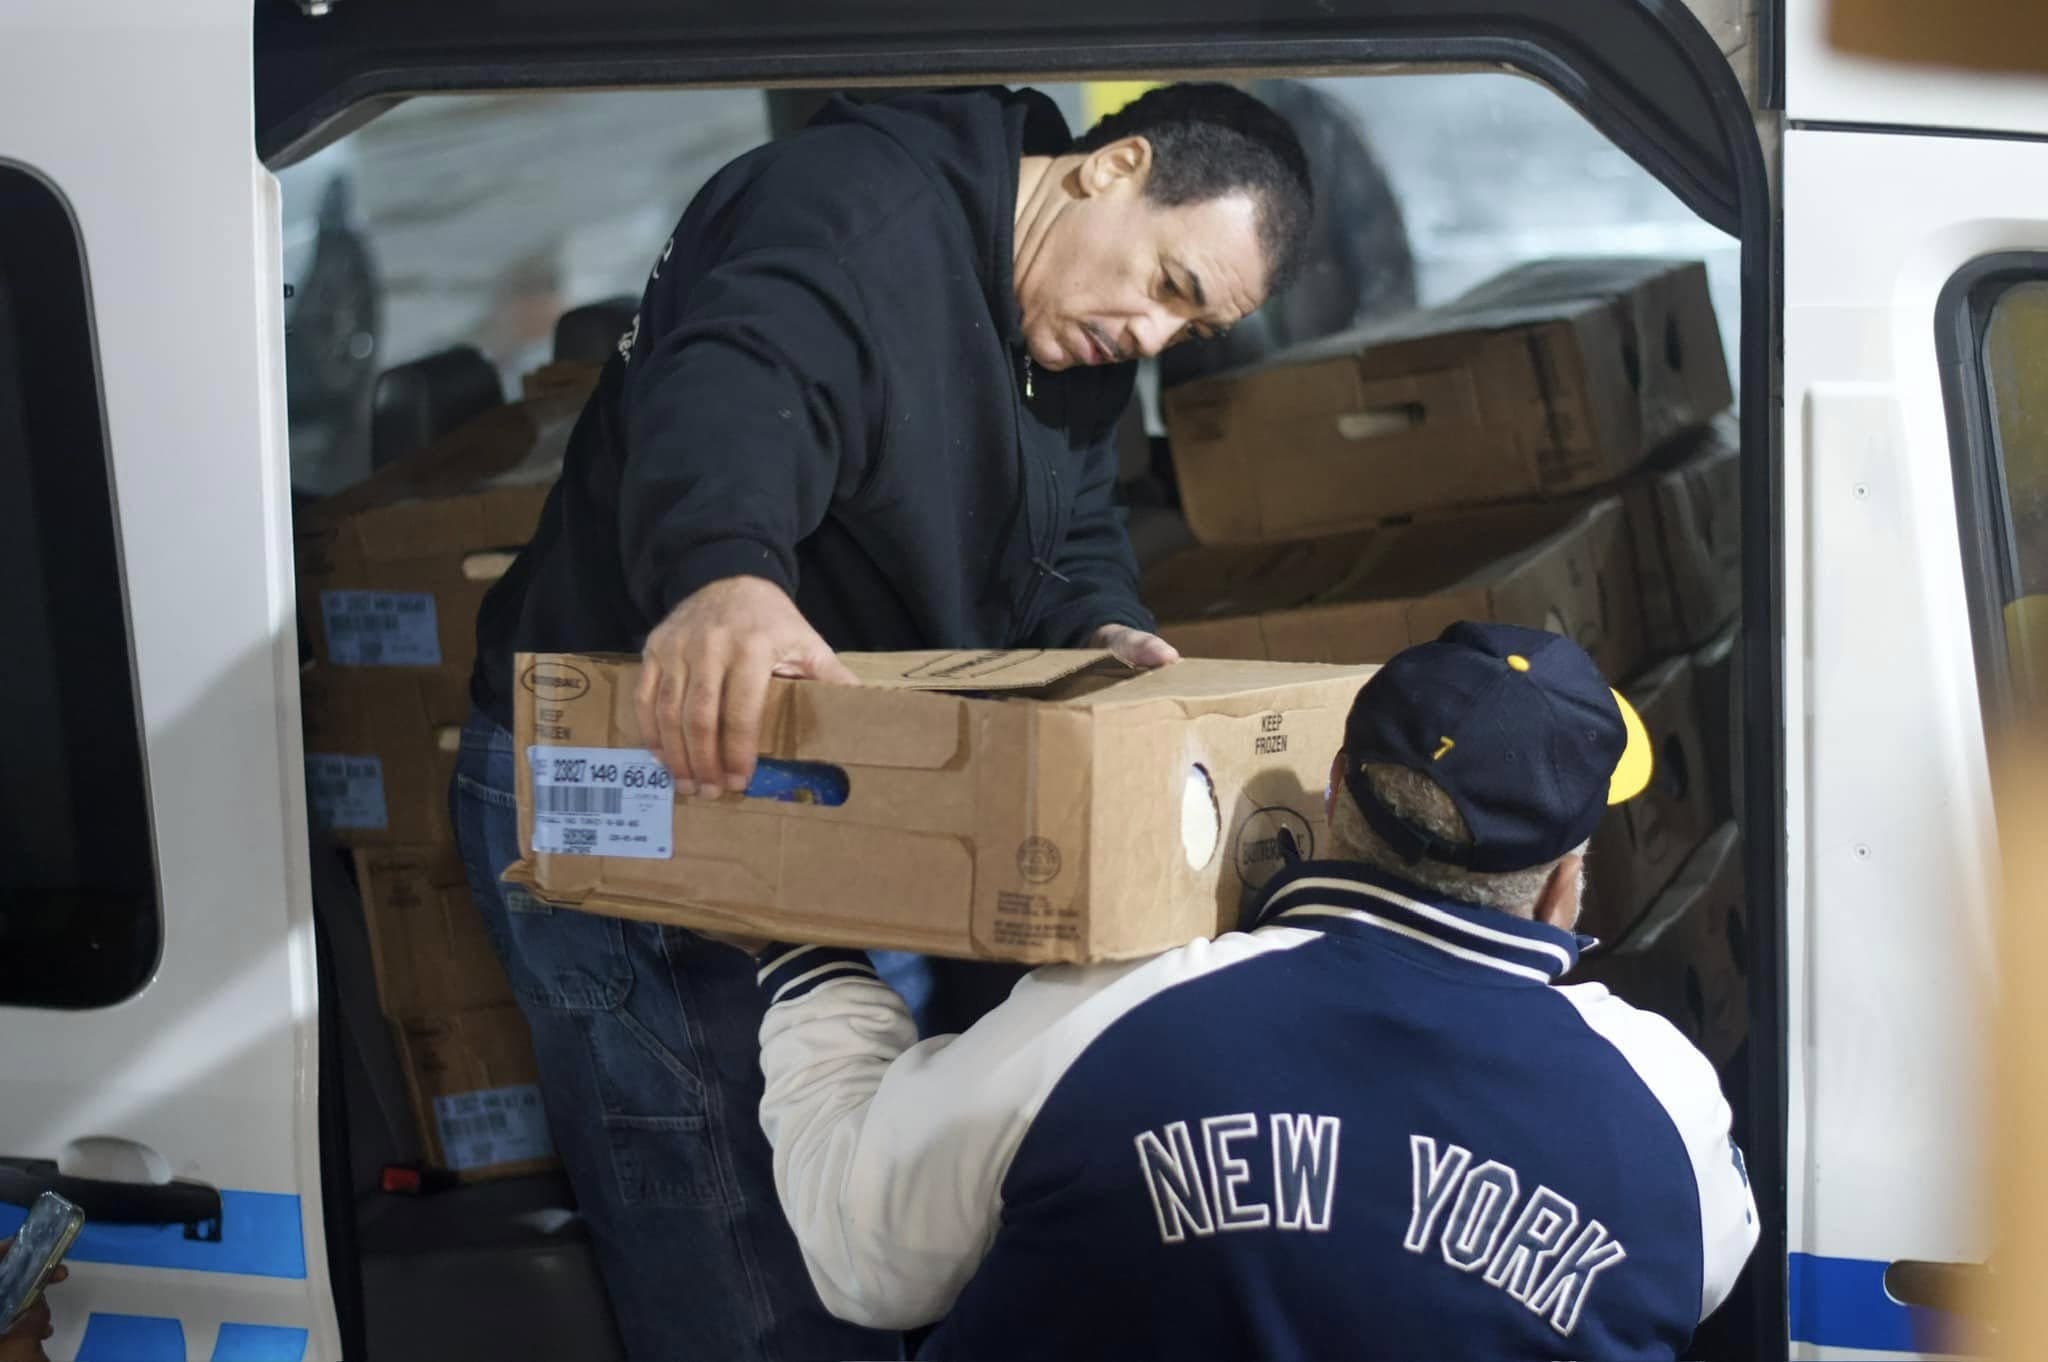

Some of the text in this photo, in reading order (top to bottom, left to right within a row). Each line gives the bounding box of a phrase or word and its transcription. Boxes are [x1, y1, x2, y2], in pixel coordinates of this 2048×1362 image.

[1261, 714, 1283, 732] KEEP
[1255, 735, 1288, 755] FROZEN
[1433, 735, 1457, 761] 7
[1134, 1112, 1626, 1337] NEW YORK
